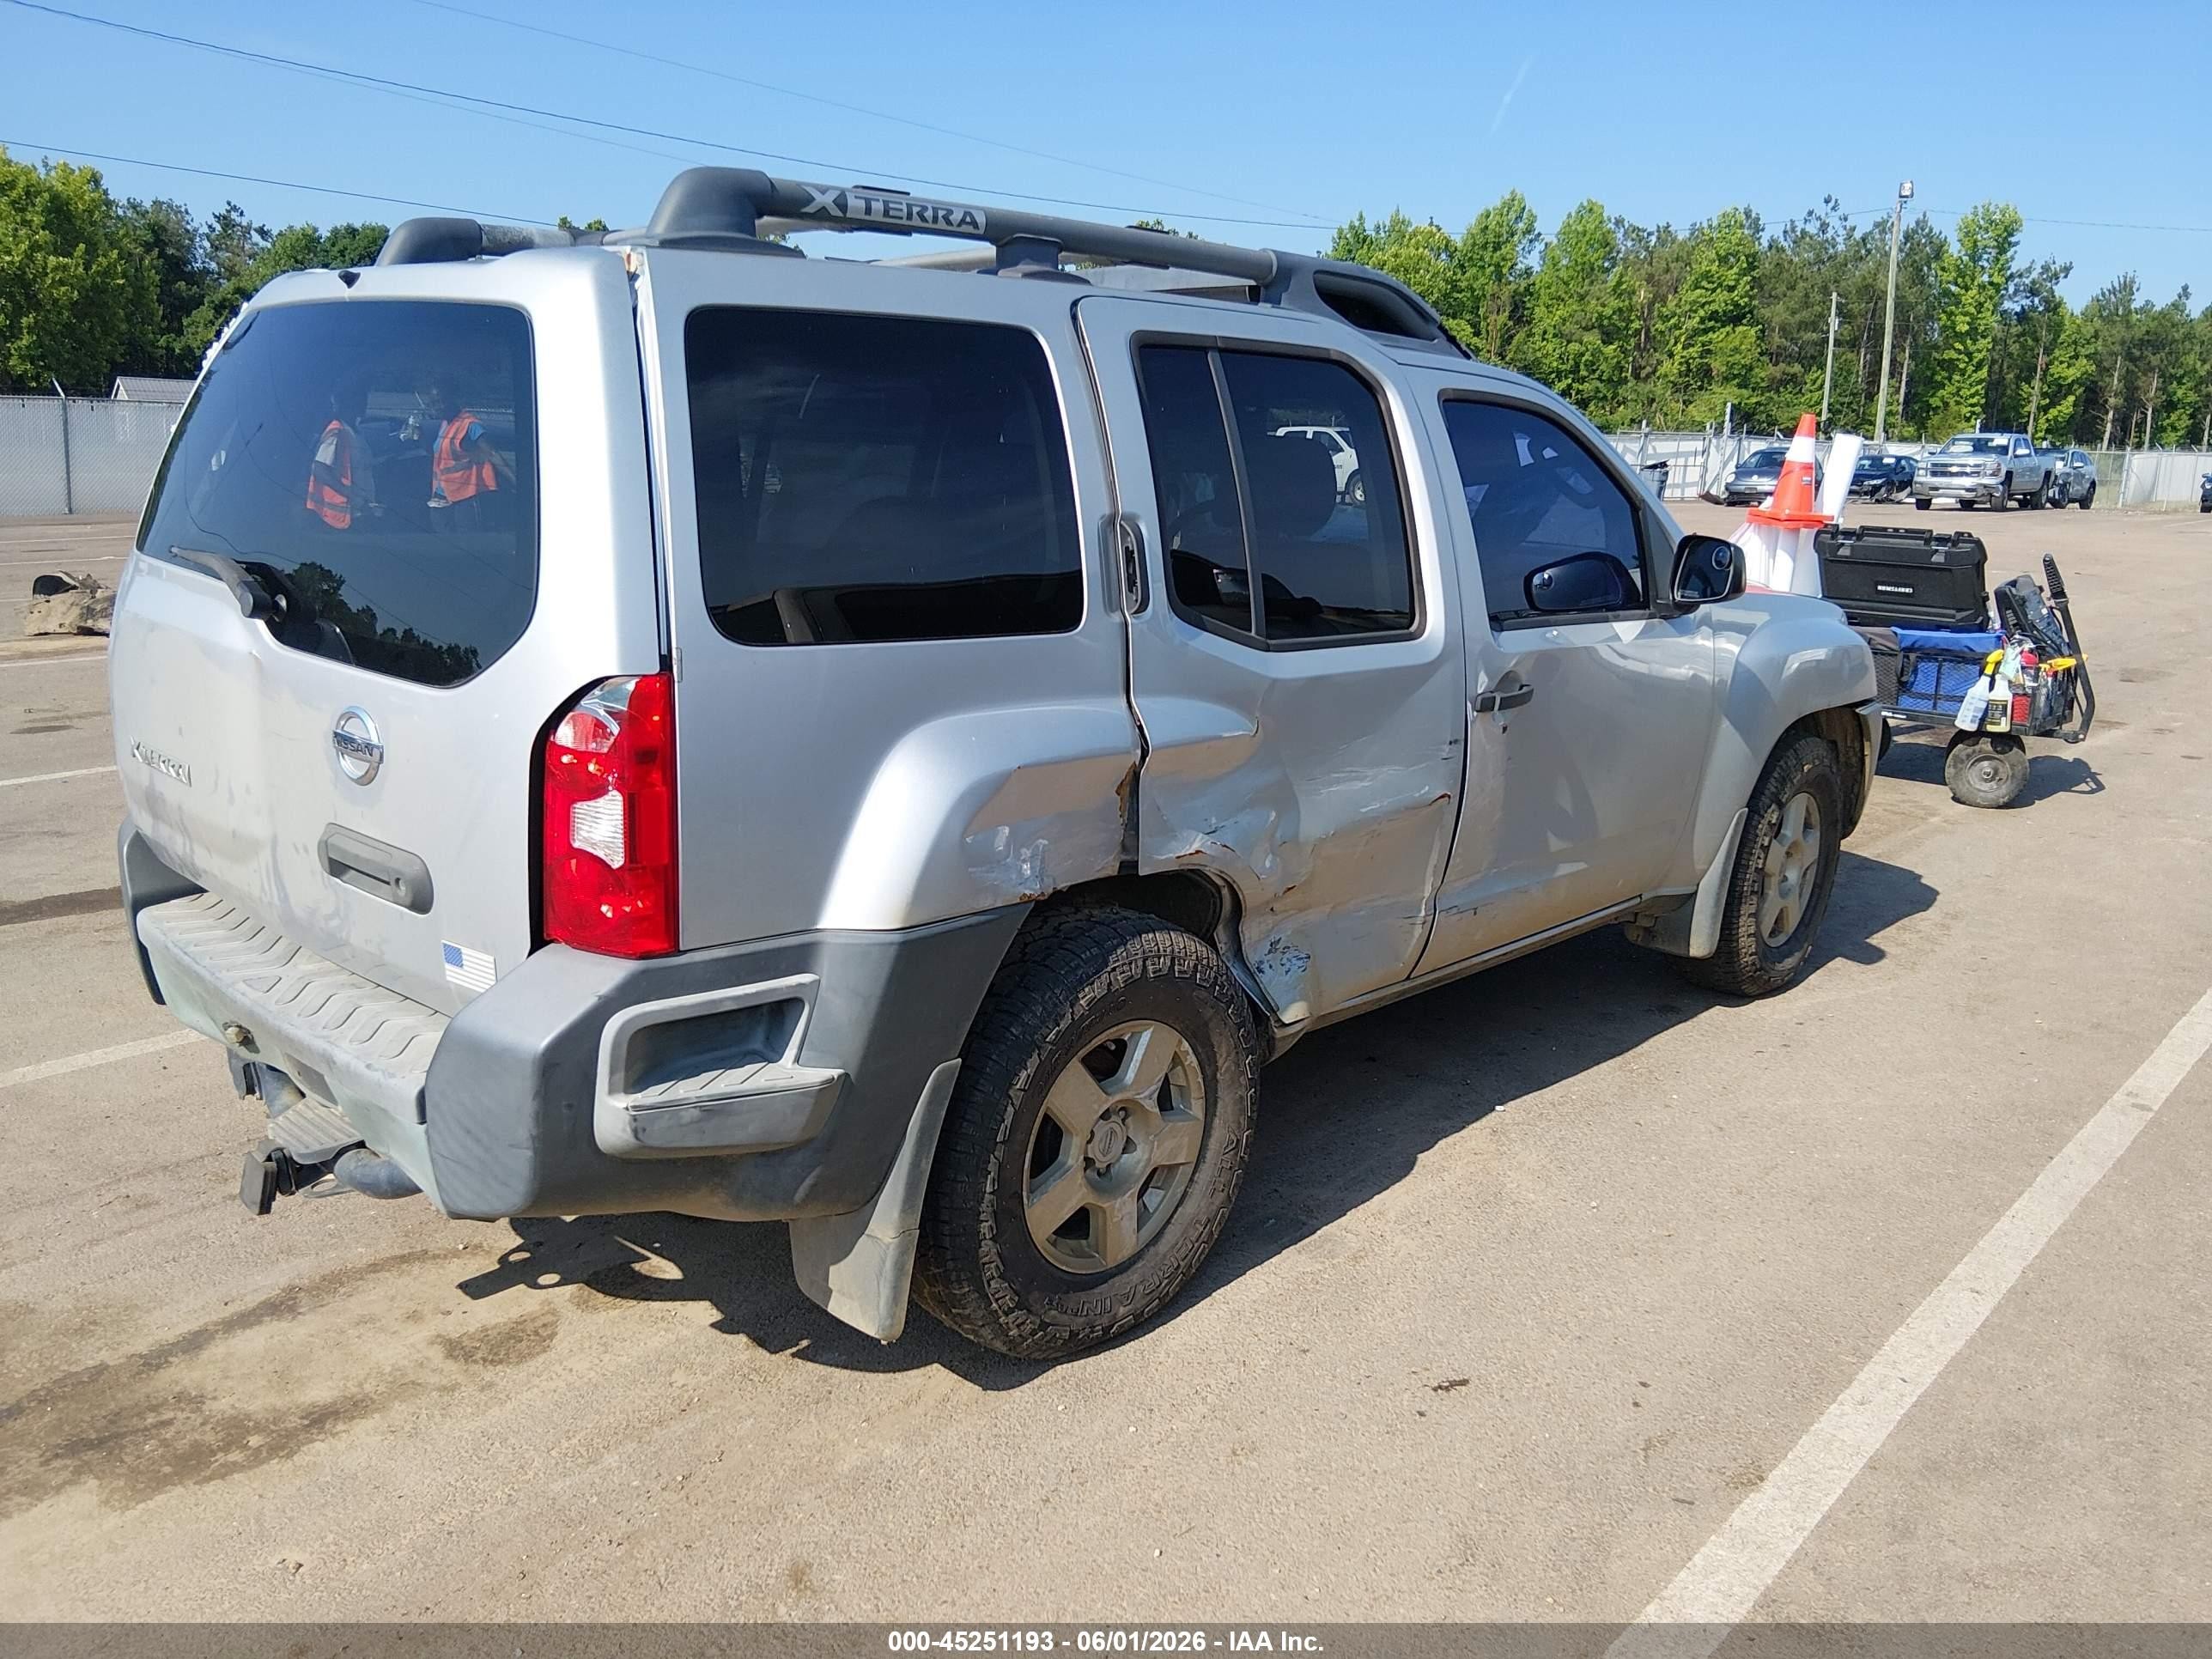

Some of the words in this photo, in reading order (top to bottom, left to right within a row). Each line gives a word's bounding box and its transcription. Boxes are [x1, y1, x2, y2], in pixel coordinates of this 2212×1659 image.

[130, 736, 192, 787] XTERRA
[336, 735, 374, 757] NISSAN
[1079, 1215, 1210, 1316] TERRAIN
